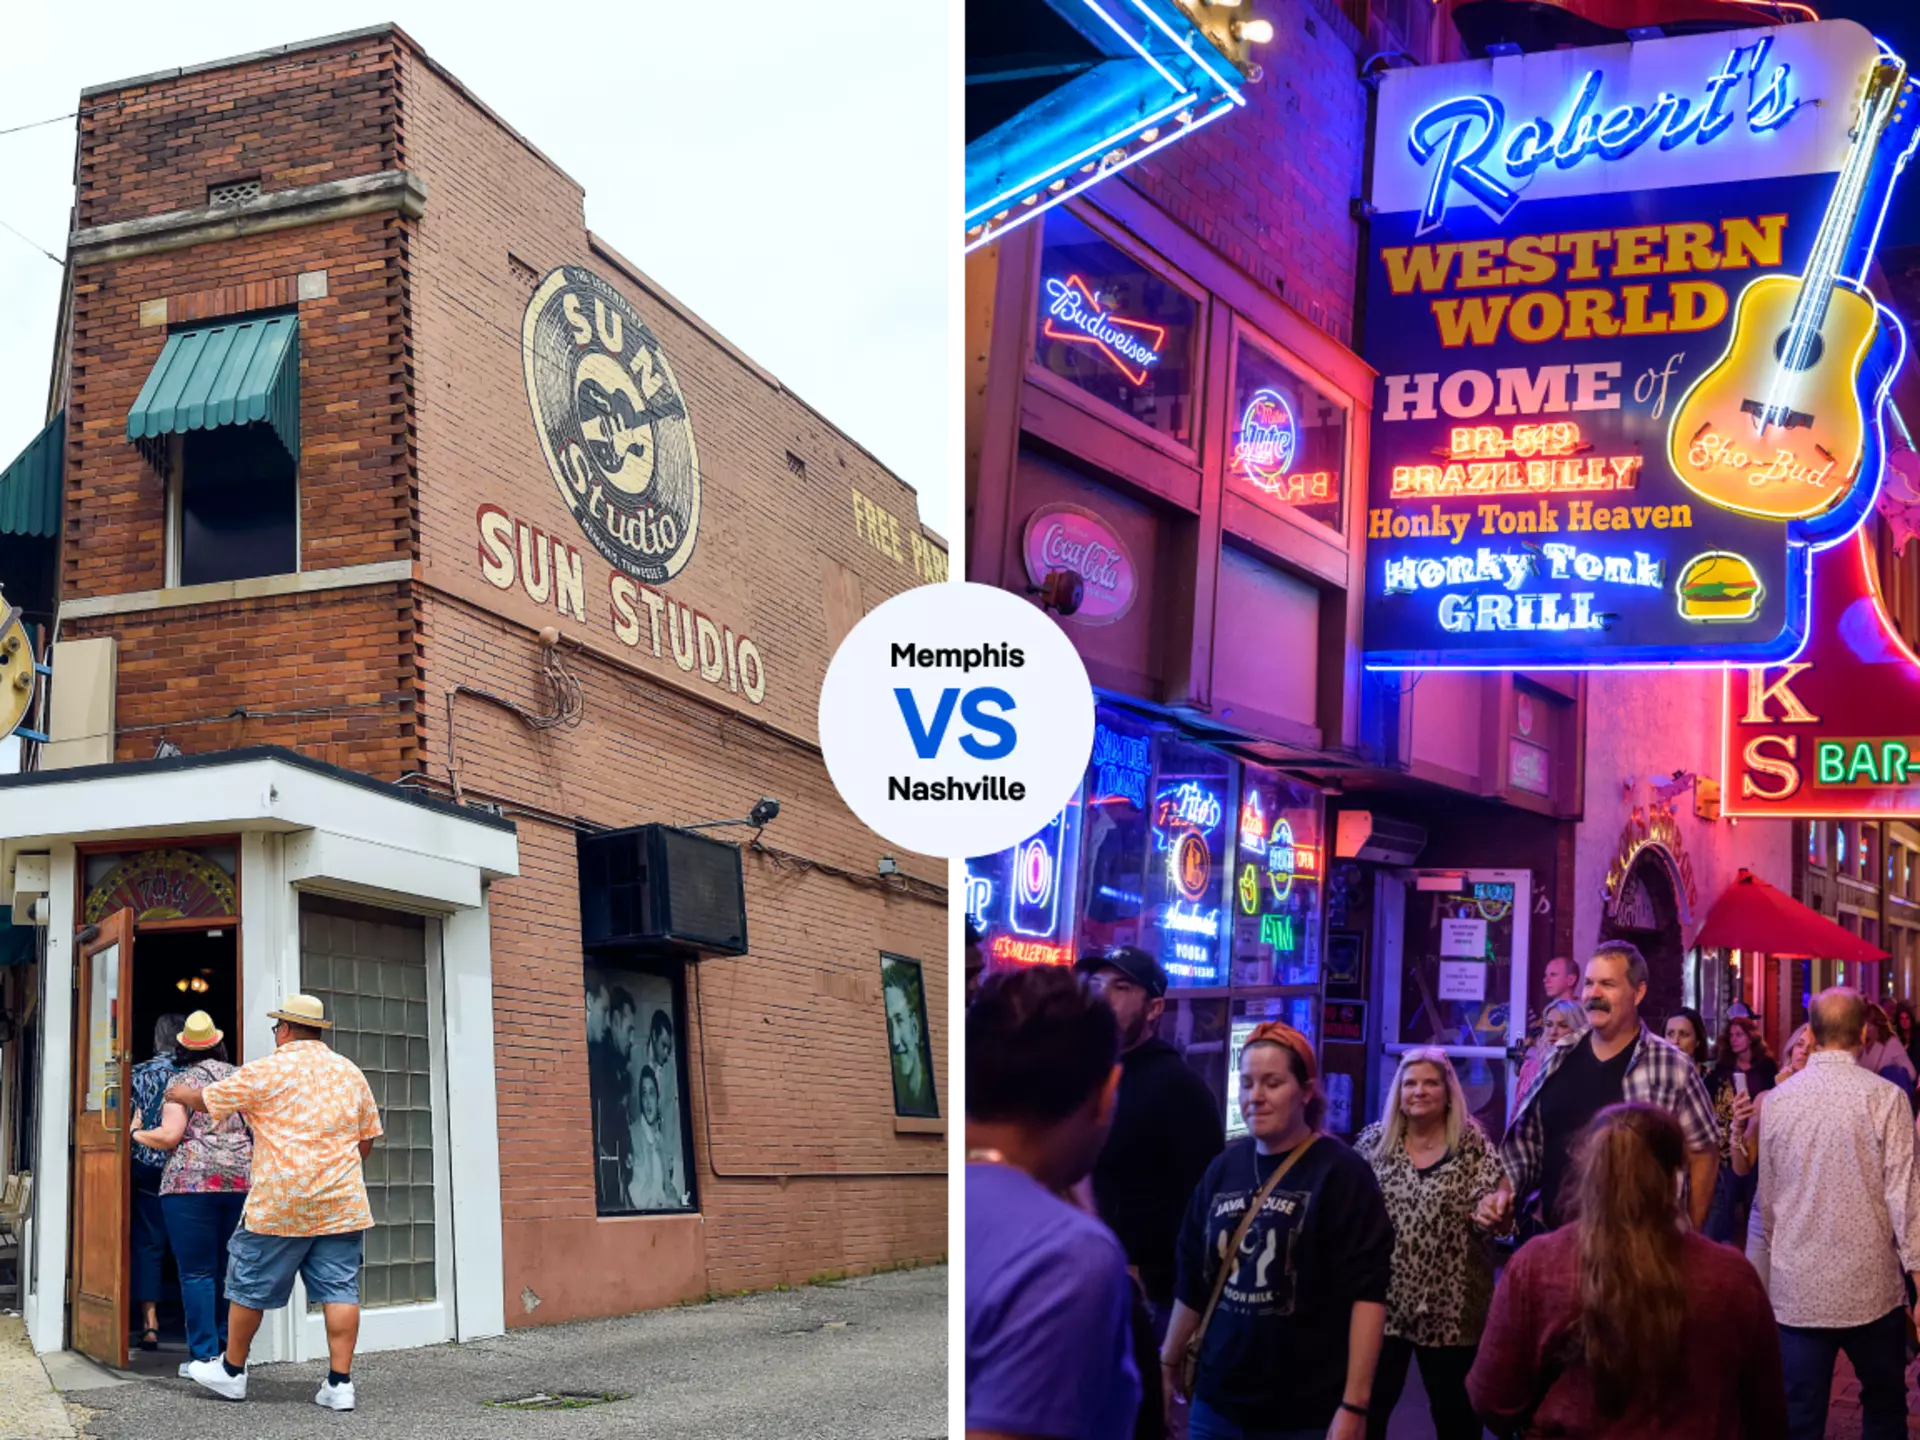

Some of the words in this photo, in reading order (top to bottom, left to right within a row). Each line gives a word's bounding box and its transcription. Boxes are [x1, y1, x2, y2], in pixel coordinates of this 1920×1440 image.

[1408, 36, 1798, 236] Robert's
[1381, 213, 1789, 294] WESTERN
[562, 292, 664, 401] SUN
[1046, 278, 1158, 366] Budweiser
[1431, 280, 1730, 348] WORLD
[1382, 362, 1622, 422] HOME
[1634, 352, 1686, 420] of
[1390, 456, 1644, 499] BRAZILBILLY
[1687, 432, 1836, 489] Sho-Bud
[559, 440, 678, 555] Studio
[852, 488, 904, 564] FREE
[1368, 505, 1471, 544] Honky
[1478, 501, 1559, 535] Tonk
[1566, 500, 1692, 533] Heaven
[1384, 547, 1536, 591] Honky
[1543, 542, 1664, 588] Tonk
[477, 503, 586, 624] SUN
[609, 570, 766, 705] STUDIO
[1438, 592, 1606, 632] GRILL
[1261, 912, 1294, 951] ATM
[1215, 1197, 1245, 1217] JAVA
[1248, 1291, 1274, 1304] MILK
